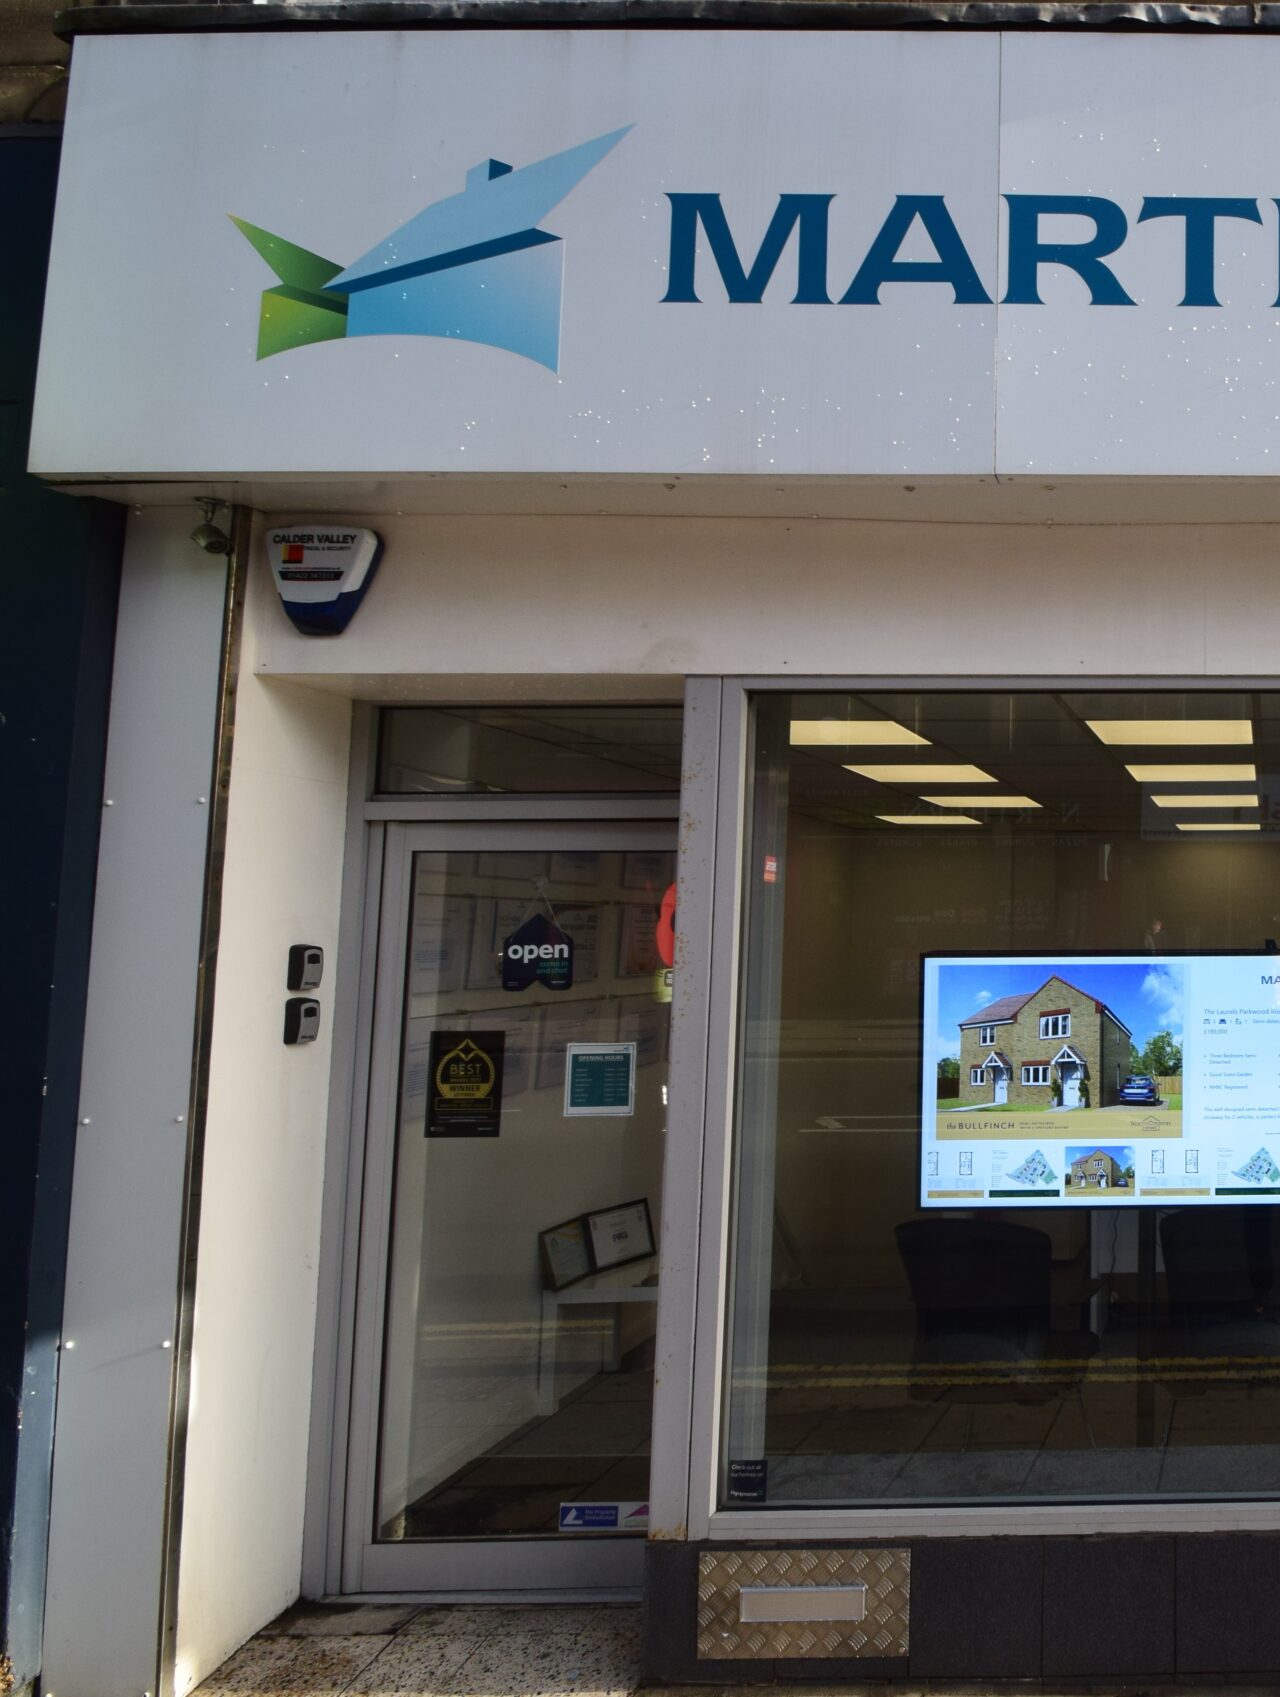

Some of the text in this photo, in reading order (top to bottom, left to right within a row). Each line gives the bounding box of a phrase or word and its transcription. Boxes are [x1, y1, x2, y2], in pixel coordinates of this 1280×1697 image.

[273, 534, 357, 544] CALDER VALLEY
[508, 943, 569, 964] open
[450, 1063, 482, 1074] BEST
[947, 1120, 957, 1130] the
[958, 1122, 1015, 1130] BULLFINCH
